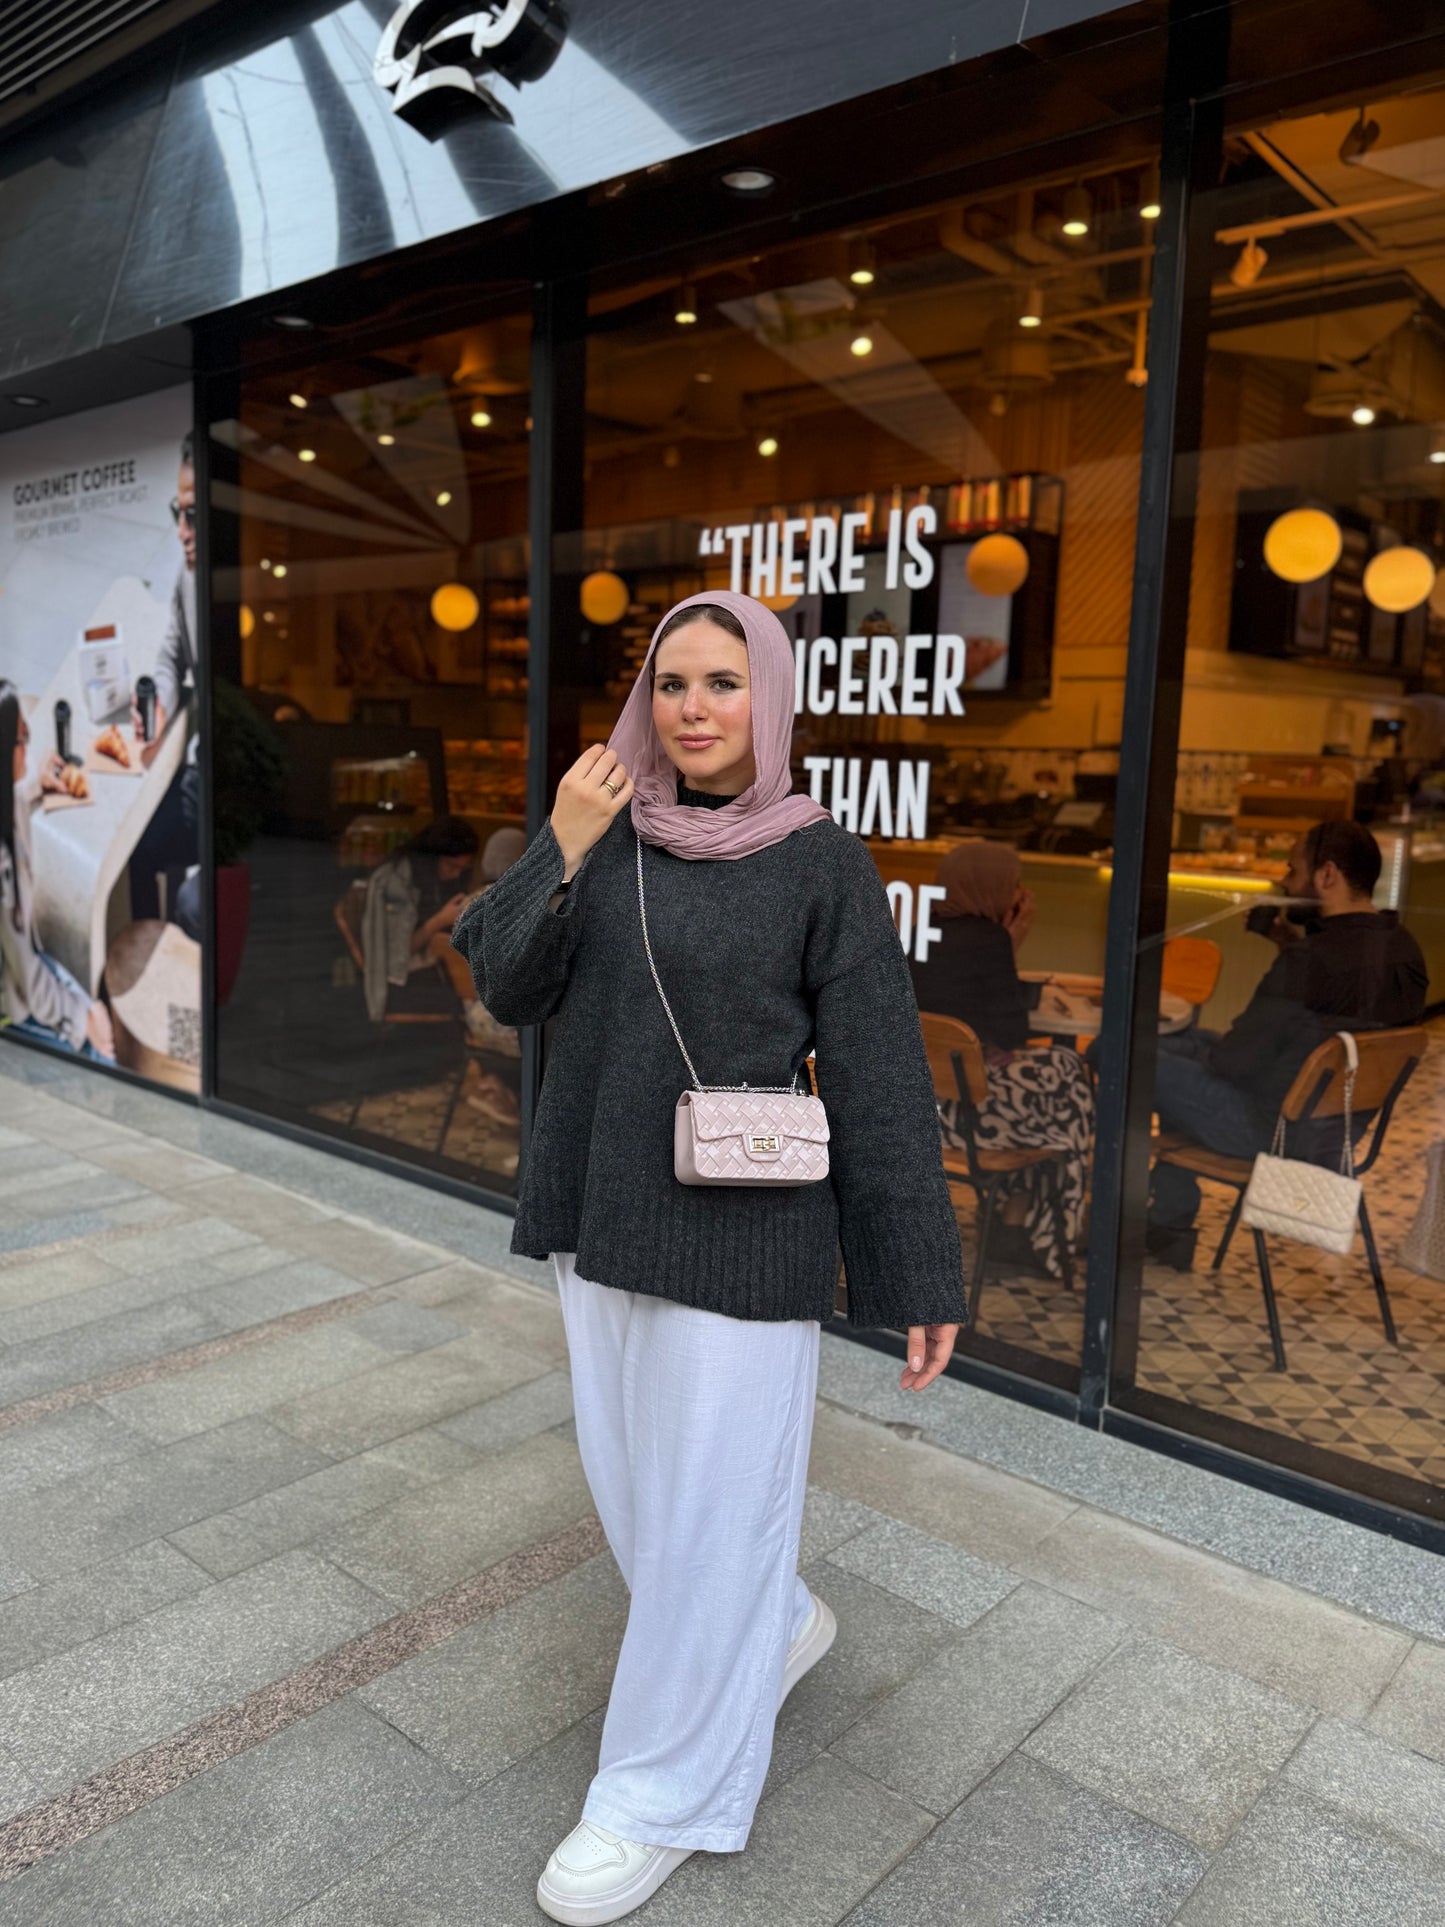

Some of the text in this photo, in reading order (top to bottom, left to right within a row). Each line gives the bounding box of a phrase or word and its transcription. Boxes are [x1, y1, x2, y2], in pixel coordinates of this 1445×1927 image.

[14, 460, 137, 506] GOURMET COFFEE
[699, 504, 937, 599] “THERE IS
[803, 756, 931, 840] THAN
[885, 880, 947, 963] OF
